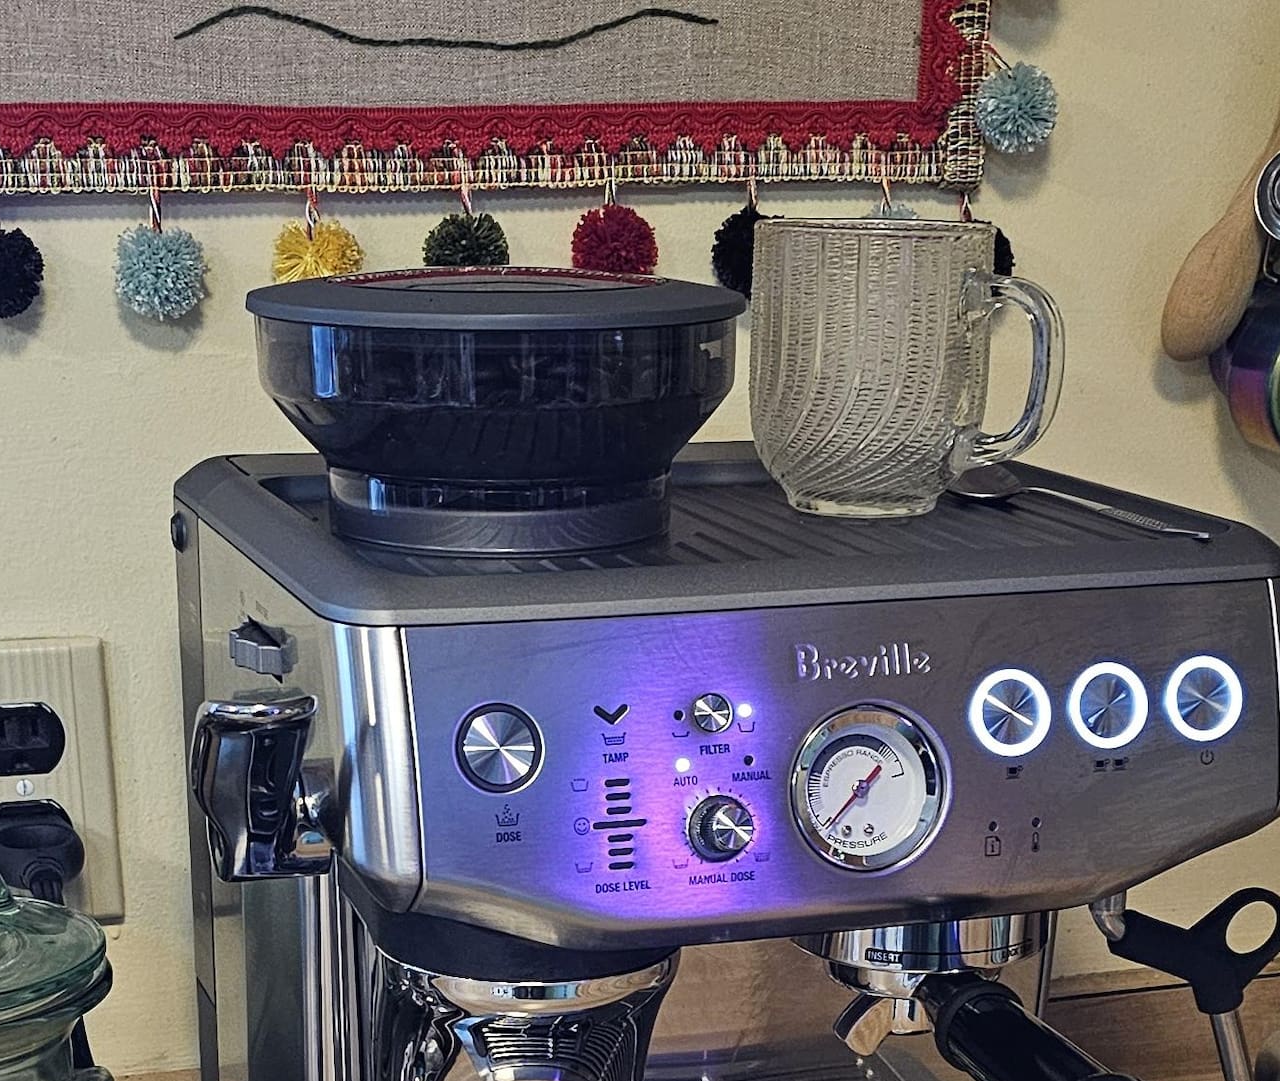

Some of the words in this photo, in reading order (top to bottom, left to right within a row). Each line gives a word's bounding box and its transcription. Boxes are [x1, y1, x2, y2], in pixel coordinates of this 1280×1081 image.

[795, 642, 931, 681] Breville
[700, 744, 731, 756] FILTER
[602, 752, 629, 764] TAMP
[823, 750, 854, 787] ESPRESSO
[673, 776, 698, 787] AUTO
[731, 770, 772, 783] MANUAL
[496, 831, 522, 843] DOSE
[827, 832, 888, 849] PRESSURE
[688, 873, 728, 886] MANUAL
[730, 871, 756, 882] DOSE
[595, 883, 621, 894] DOSE
[622, 880, 651, 892] LEVEL
[867, 950, 900, 964] INSERT
